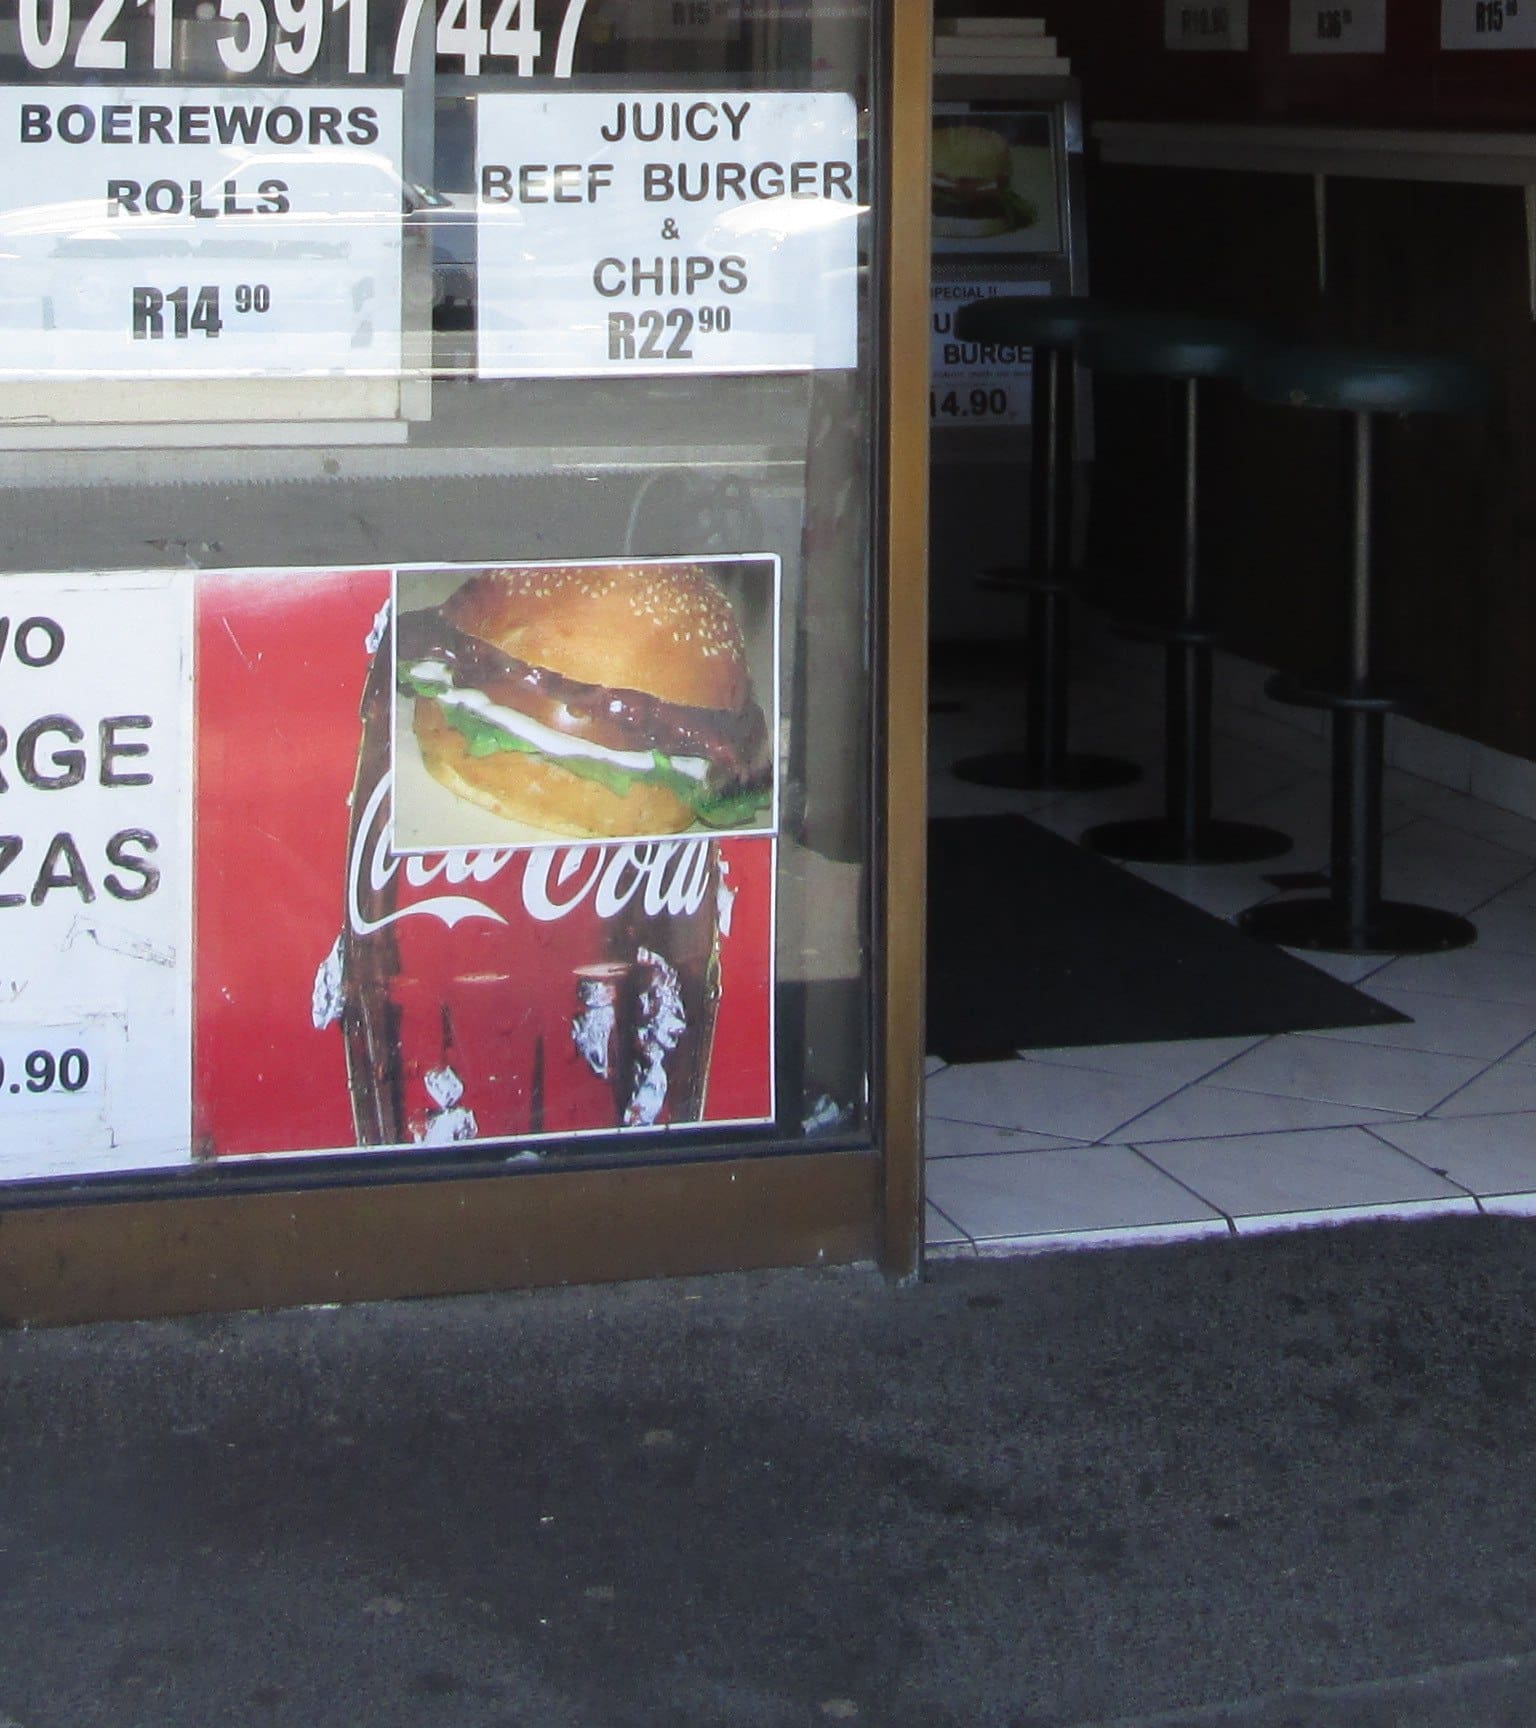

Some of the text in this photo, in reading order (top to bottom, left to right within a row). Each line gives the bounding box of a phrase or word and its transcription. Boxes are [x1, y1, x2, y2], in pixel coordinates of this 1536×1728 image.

[19, 103, 380, 146] BOEREWORS
[600, 101, 753, 143] JUICY
[106, 178, 291, 219] ROLLS
[481, 161, 854, 205] BEEF BURGER
[660, 217, 681, 242] &
[592, 255, 749, 298] CHIPS
[943, 343, 1034, 366] BURGE
[930, 387, 1007, 418] 14.90
